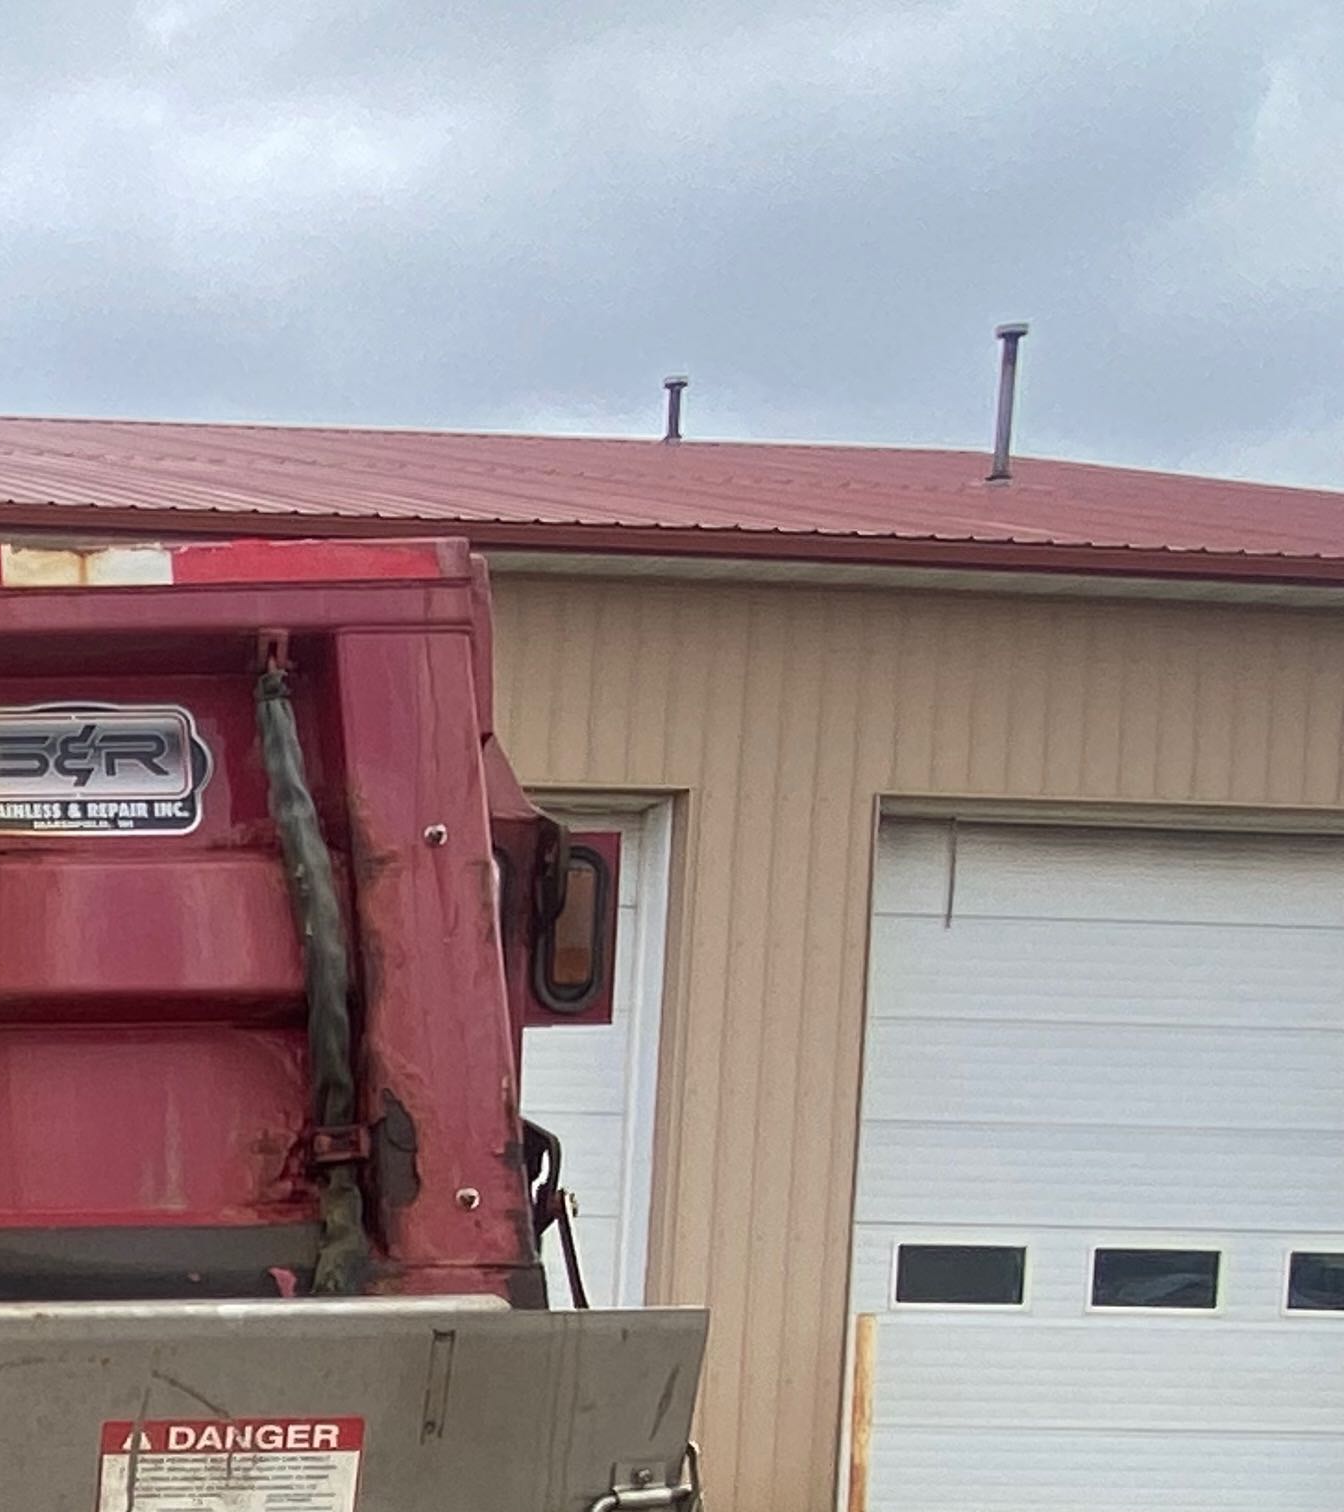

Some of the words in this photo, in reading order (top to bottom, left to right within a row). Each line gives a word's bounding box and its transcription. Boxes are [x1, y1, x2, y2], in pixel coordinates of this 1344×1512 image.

[67, 802, 82, 819] &
[87, 801, 149, 819] REPAIR
[154, 801, 190, 818] INC.
[168, 1424, 340, 1450] DANGER
